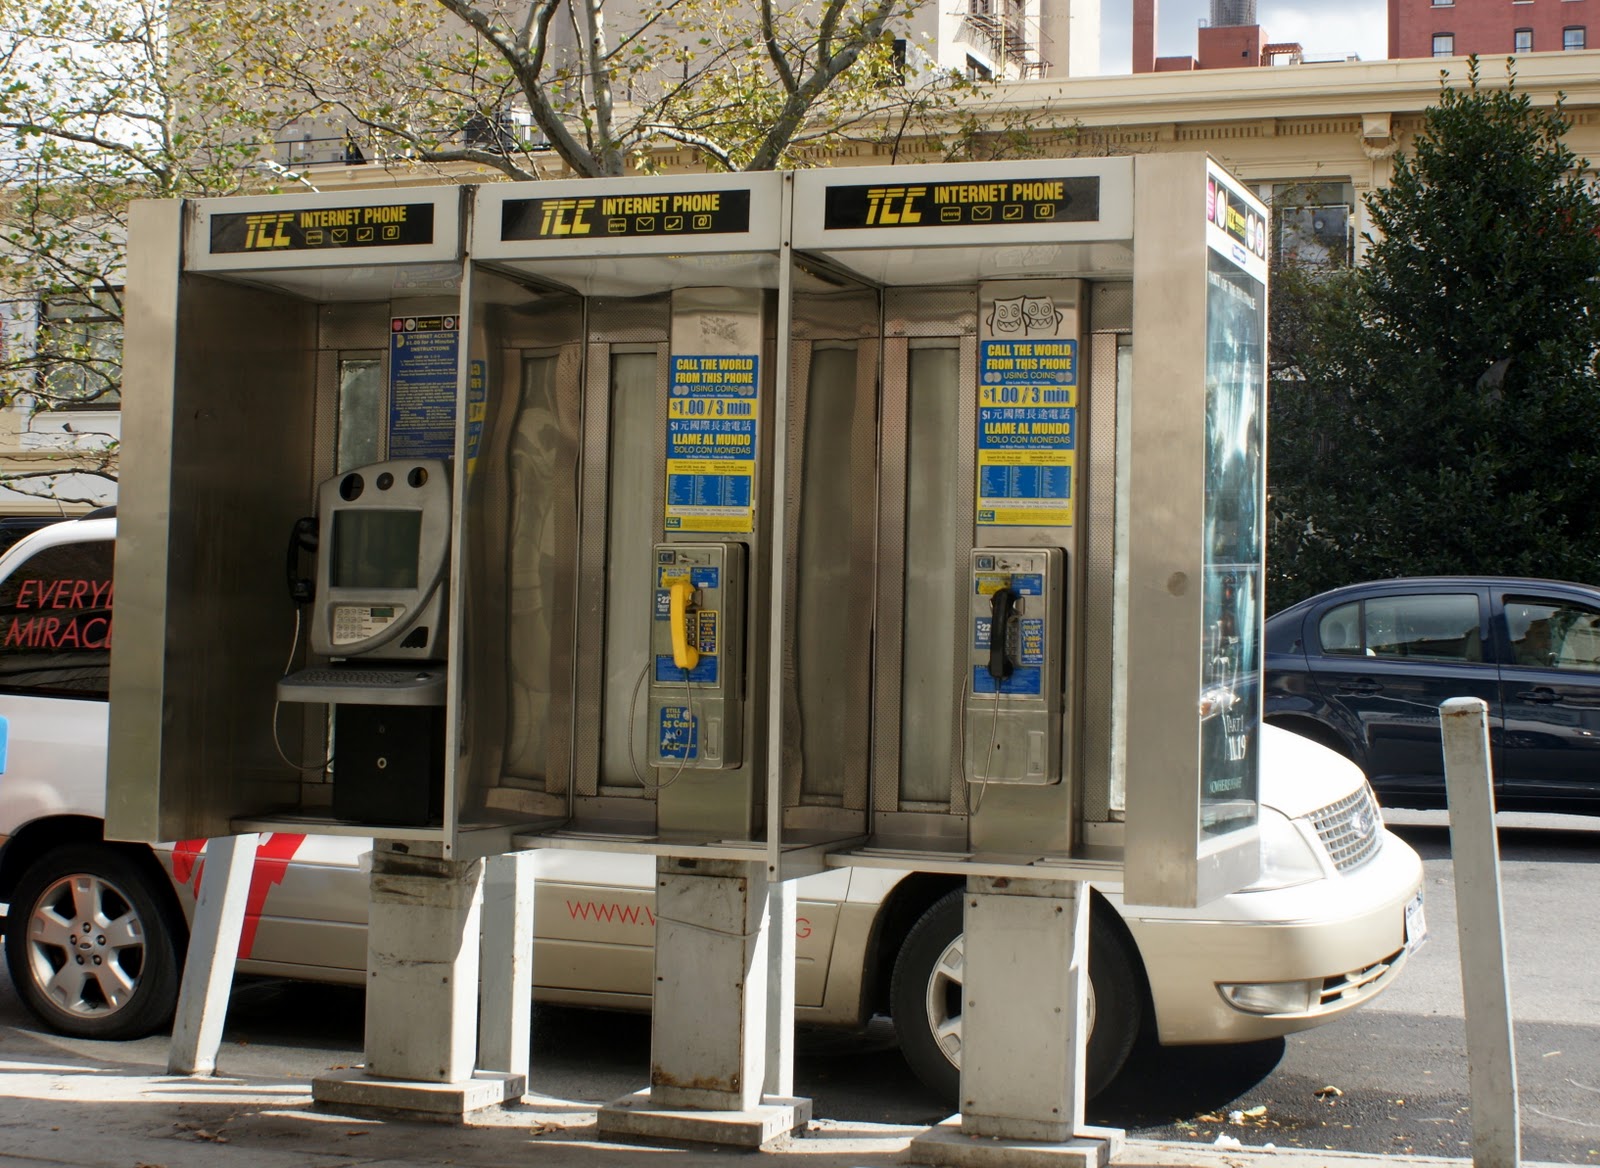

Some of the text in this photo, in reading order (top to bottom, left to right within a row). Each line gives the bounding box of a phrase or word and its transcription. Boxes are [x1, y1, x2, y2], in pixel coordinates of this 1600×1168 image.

[866, 182, 1063, 224] TCC INTERNET PHONE
[540, 194, 720, 236] TCC INTERNET PHONE
[245, 206, 407, 248] TCC INTERNET PHONE
[988, 344, 1071, 356] CALL THE WORLD
[676, 358, 753, 370] CALL THE WORLD
[986, 358, 1072, 370] FROM THIS PHONE
[676, 372, 753, 384] FROM THIS PHONE
[984, 387, 1070, 404] $1.00 / 3 min
[672, 400, 751, 416] $1.00 / 3 min
[985, 423, 1070, 434] LLAME AL MUNDO
[673, 434, 751, 446] LLAME AL MUNDO
[986, 436, 1071, 444] SOLO CON MONEDAS
[1226, 714, 1240, 732] PART
